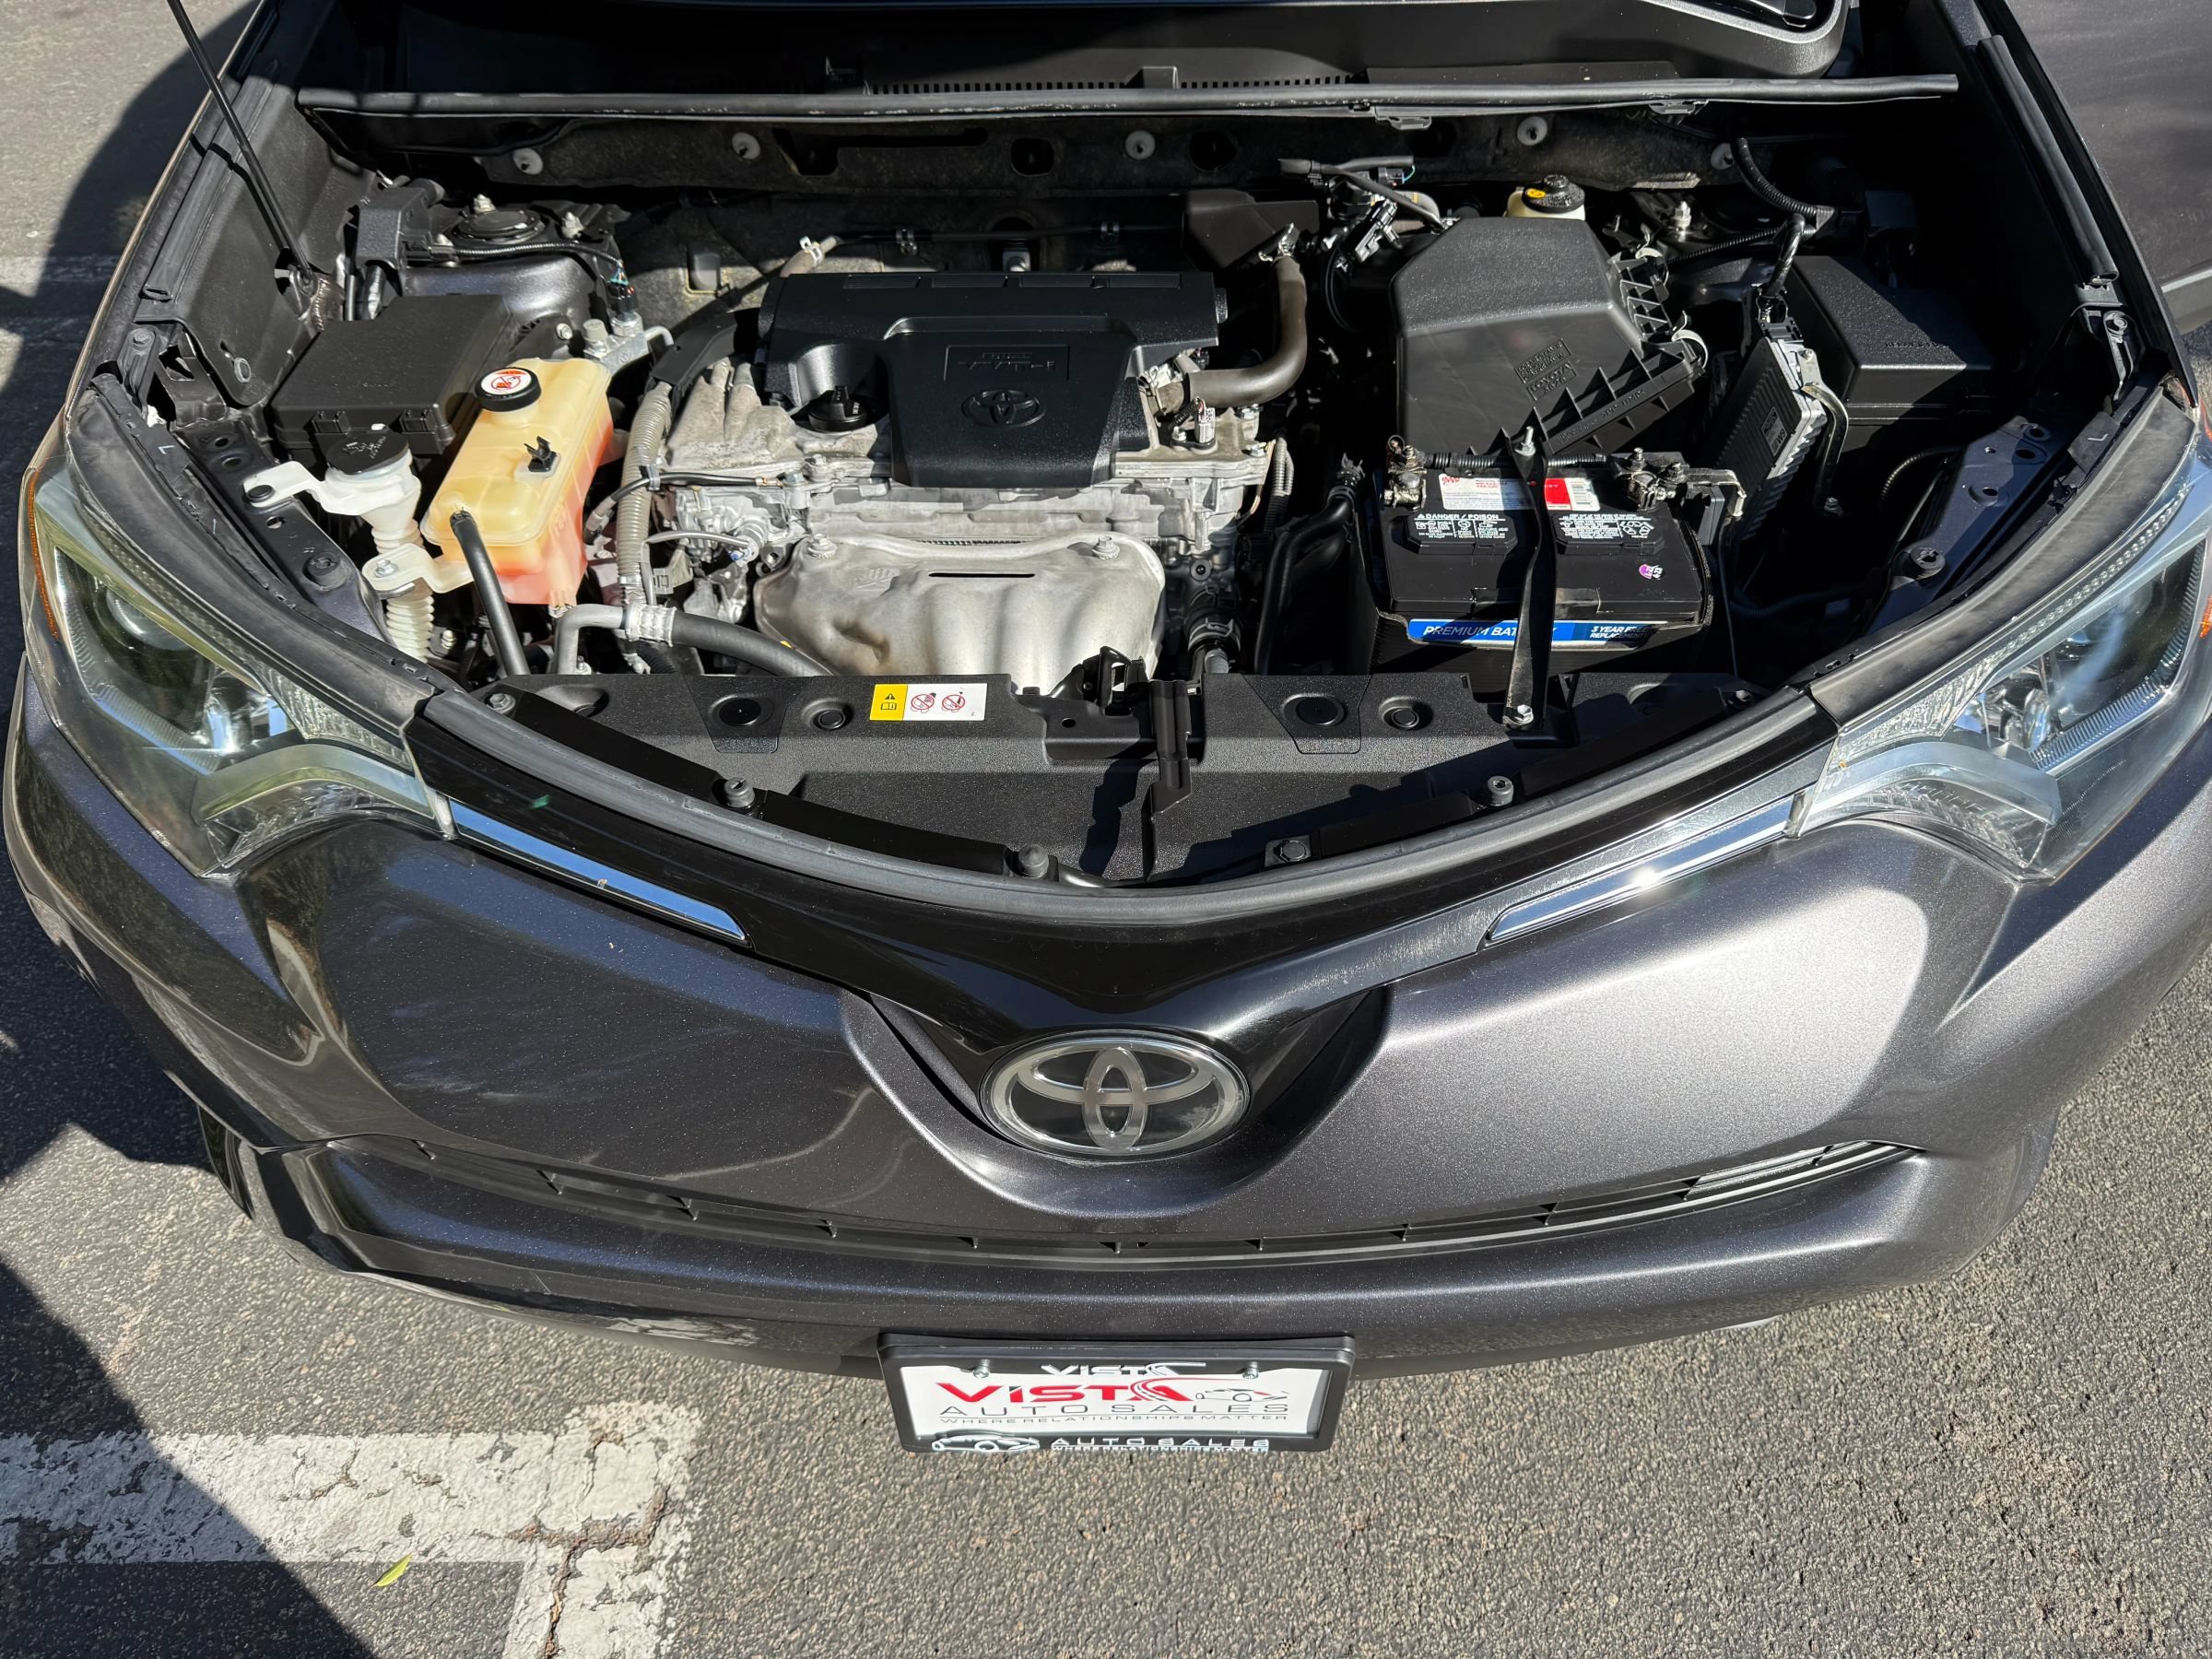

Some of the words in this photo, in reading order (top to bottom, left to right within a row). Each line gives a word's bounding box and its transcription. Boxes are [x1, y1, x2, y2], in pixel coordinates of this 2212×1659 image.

[1422, 626, 1488, 636] PREMIUM
[939, 1404, 1088, 1417] AUTO
[1111, 1403, 1288, 1414] SALES
[1023, 1415, 1194, 1424] RELATIONSHIPS
[1051, 1436, 1146, 1446] AUTO
[1158, 1436, 1270, 1446] SALES
